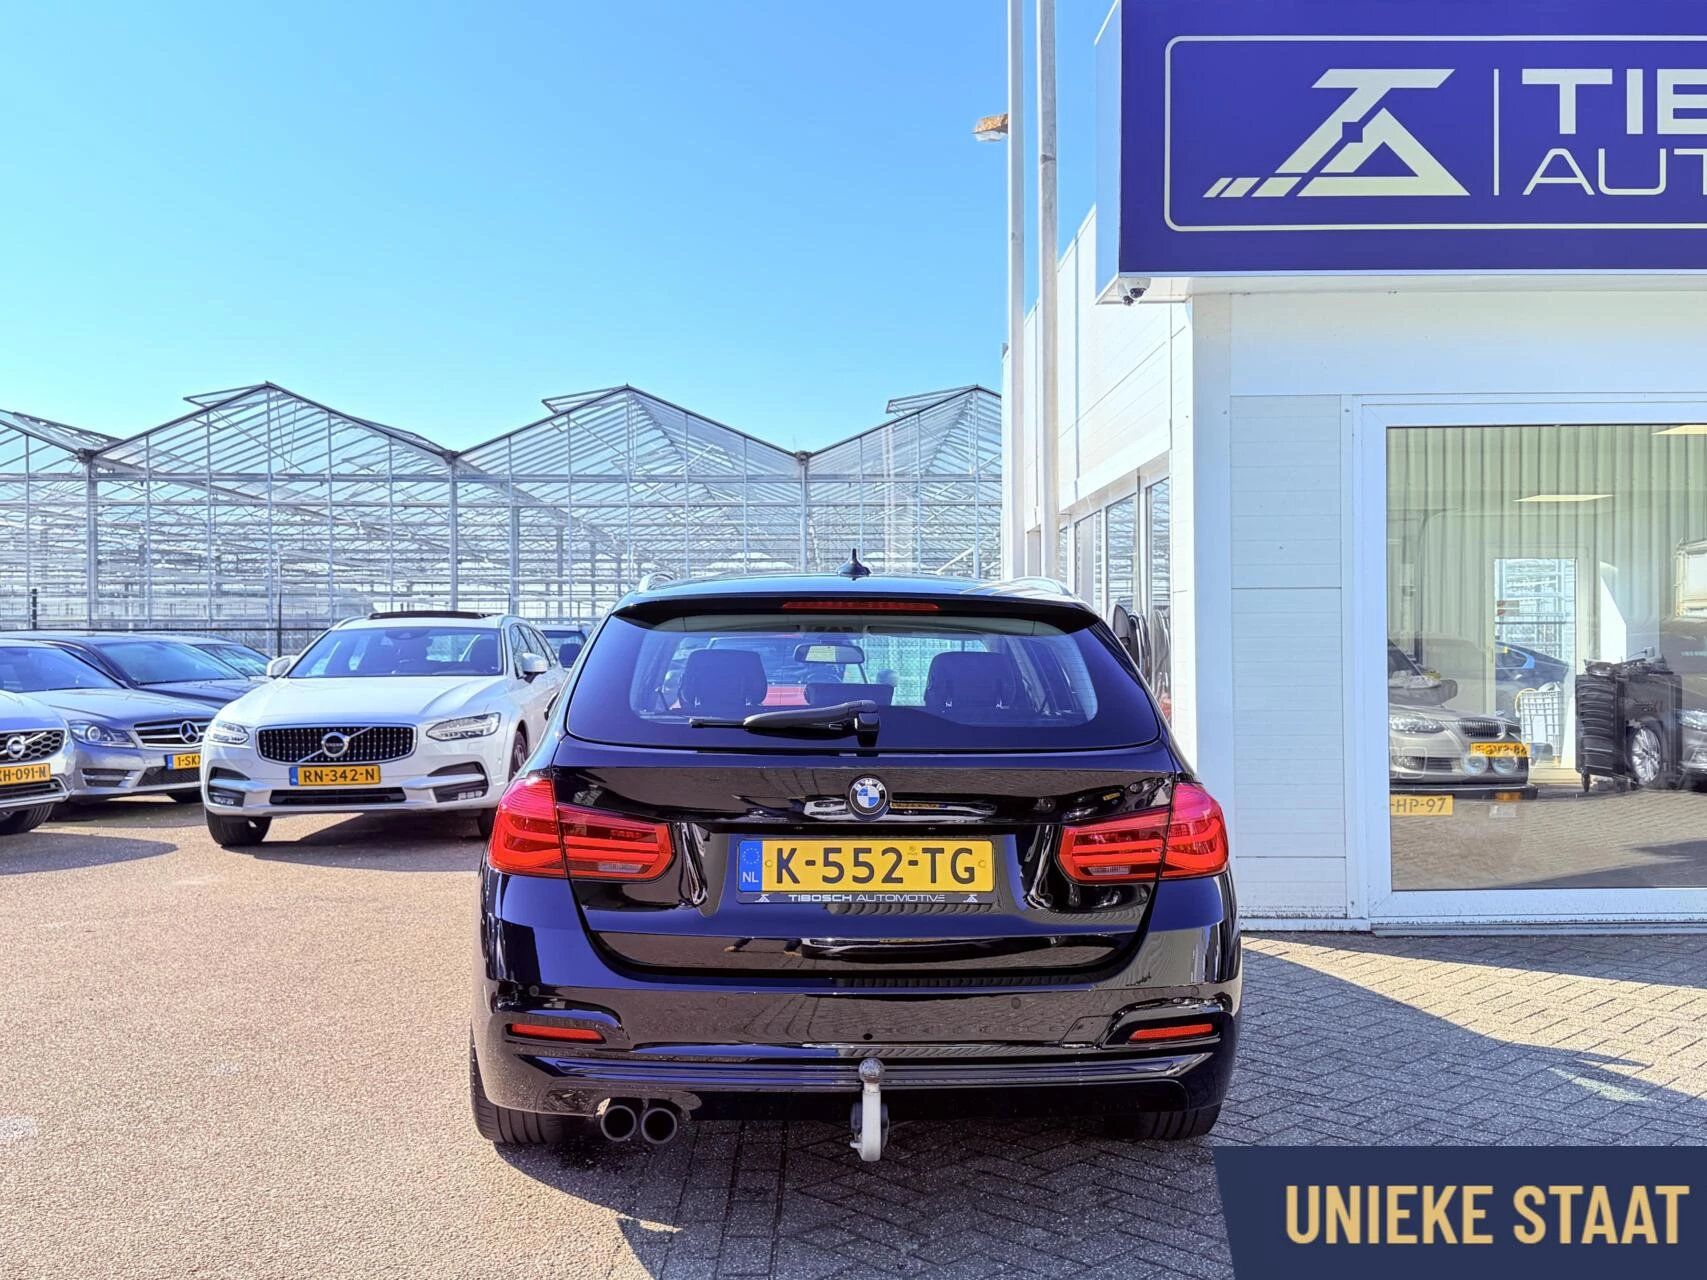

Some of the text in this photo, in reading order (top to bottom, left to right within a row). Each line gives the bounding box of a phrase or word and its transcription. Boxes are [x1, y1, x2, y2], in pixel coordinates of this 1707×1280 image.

[303, 767, 375, 783] RN-342-N
[775, 847, 976, 885] K-552-TG
[742, 871, 759, 883] NL
[788, 894, 946, 902] TIBOSCH AUTOMOTIVE
